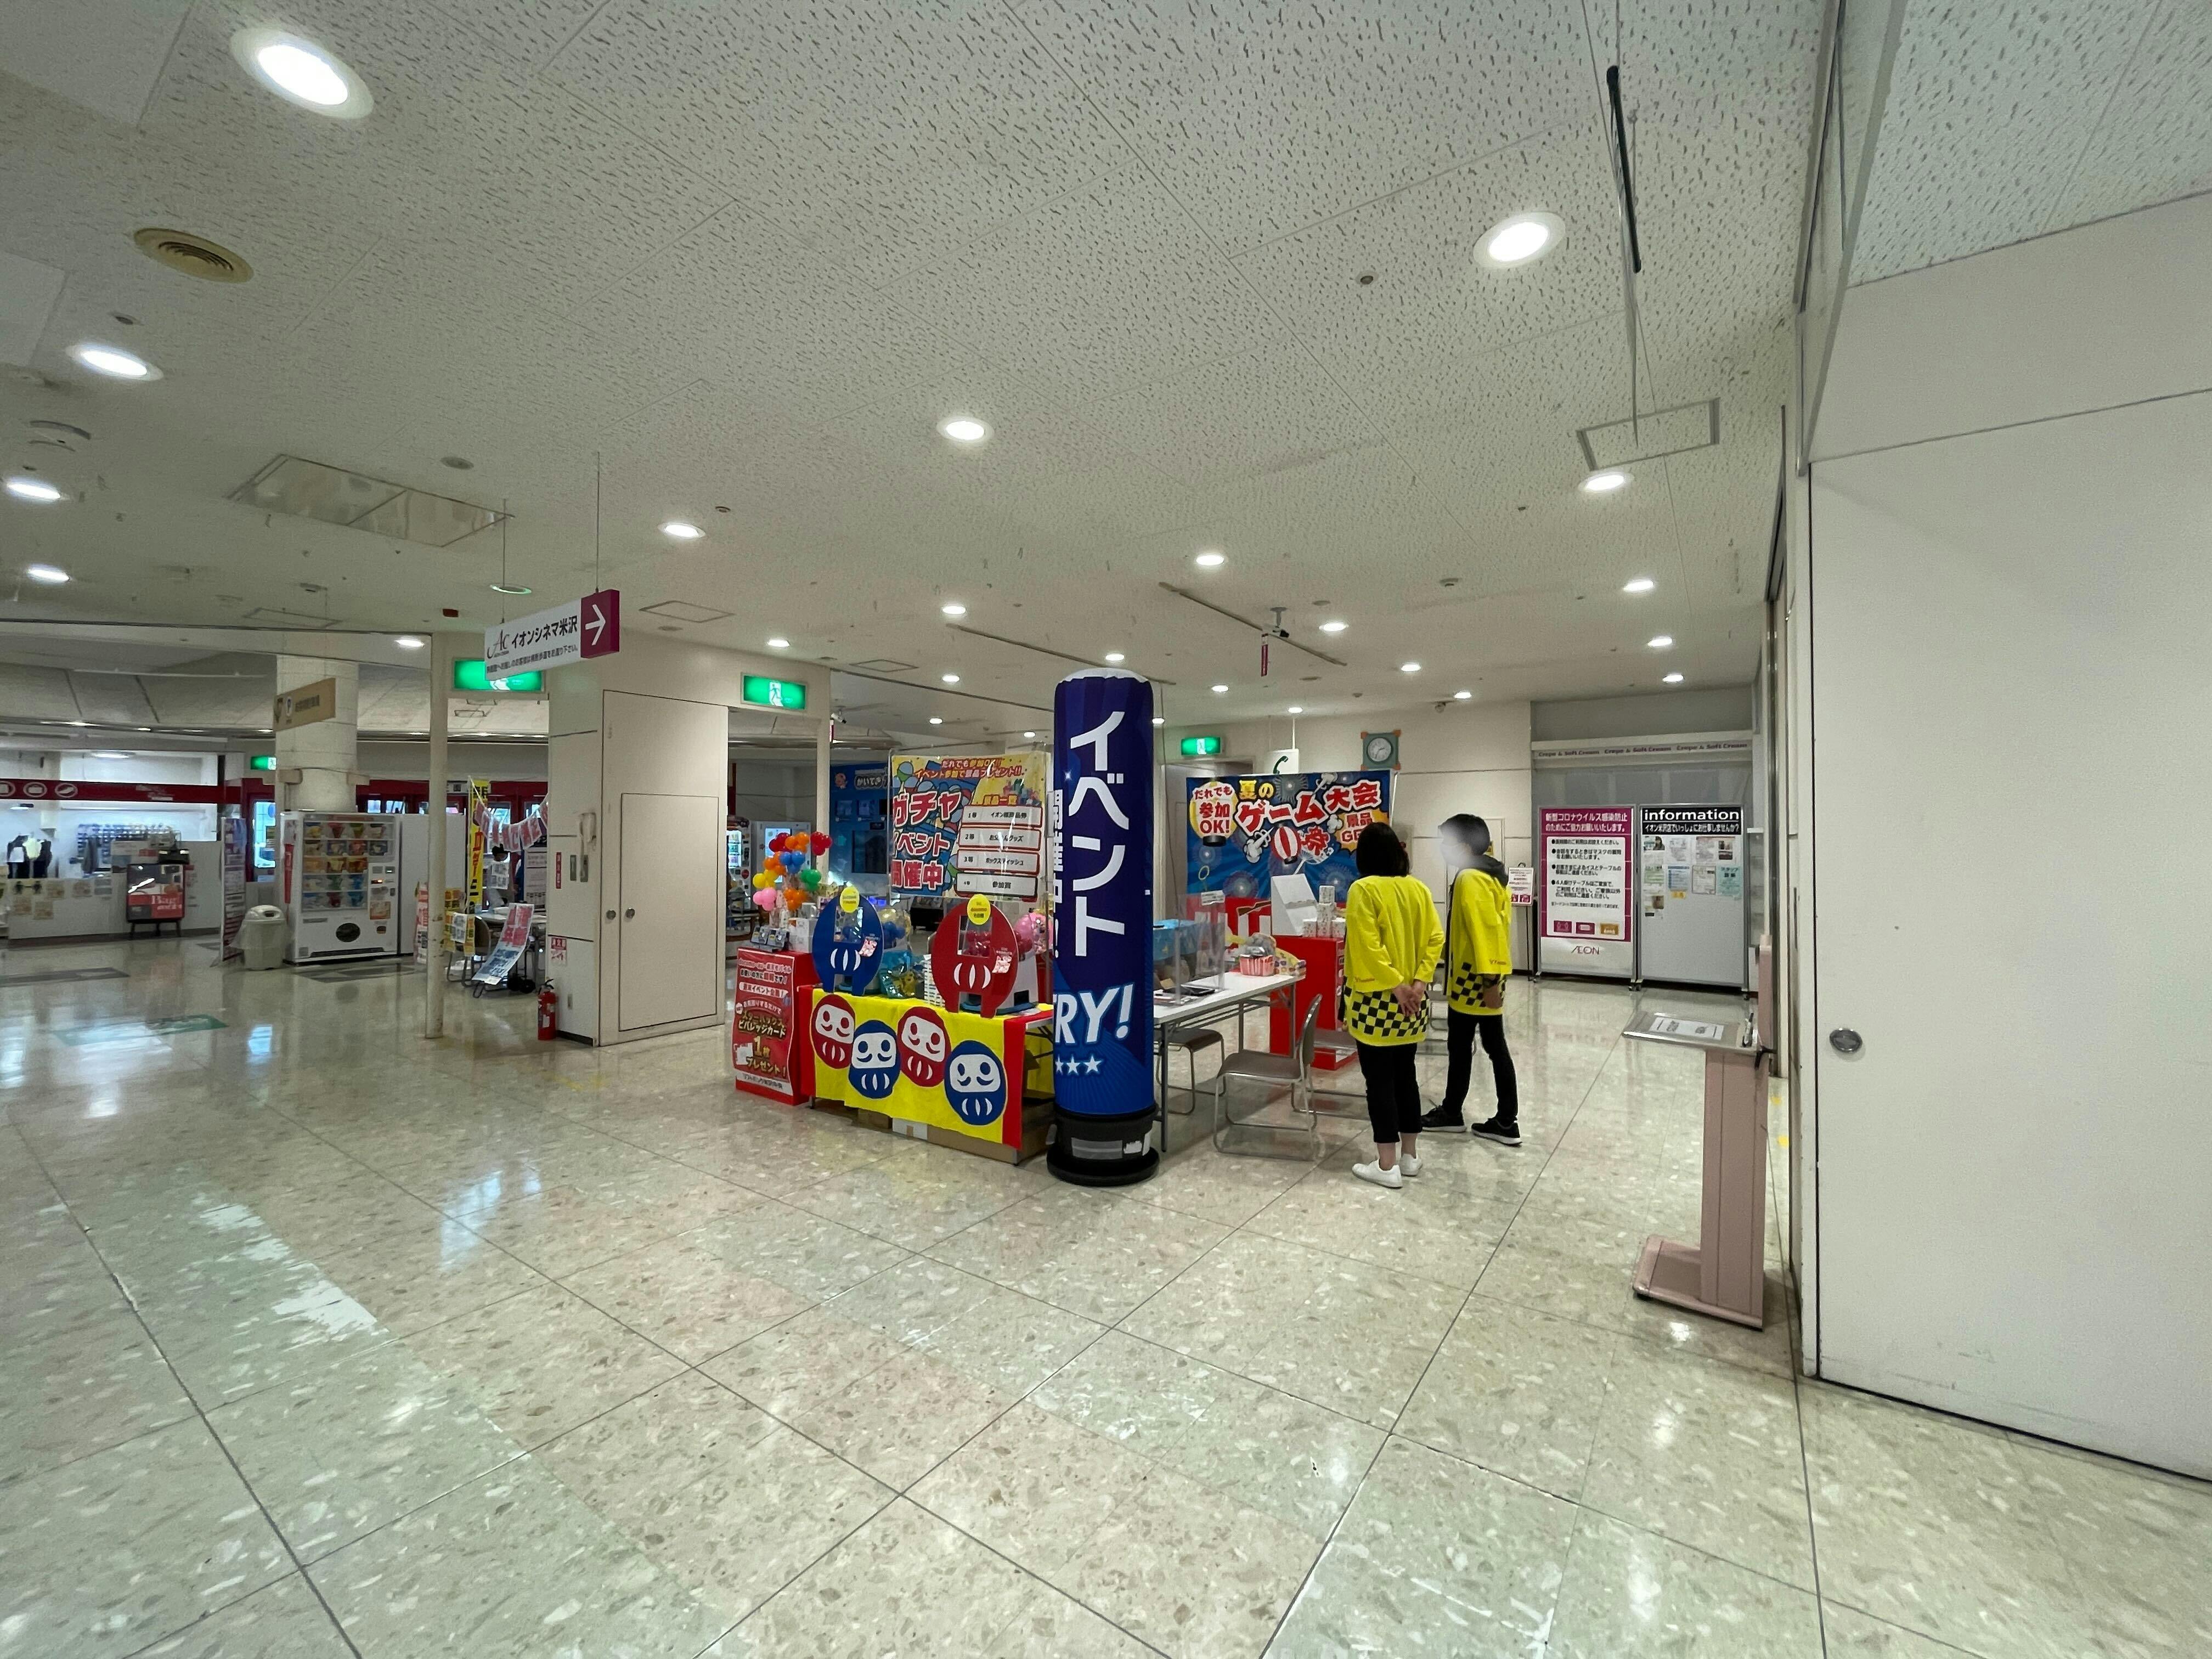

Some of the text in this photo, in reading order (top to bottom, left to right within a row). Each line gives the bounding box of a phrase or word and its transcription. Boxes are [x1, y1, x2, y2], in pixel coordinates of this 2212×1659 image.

[512, 615, 577, 648] イオンシネマ米沢
[1194, 786, 1233, 800] だれでも
[1239, 780, 1274, 798] 夏の
[893, 791, 961, 827] ガチャ
[1199, 802, 1231, 818] 参加
[1238, 782, 1379, 833] ゲーム大会
[1645, 809, 1739, 820] information
[1069, 711, 1129, 957] イベント
[1199, 819, 1230, 833] OK!
[894, 832, 950, 857] ベント
[1053, 984, 1133, 1044] RY!
[746, 1057, 787, 1077] プレゼント!
